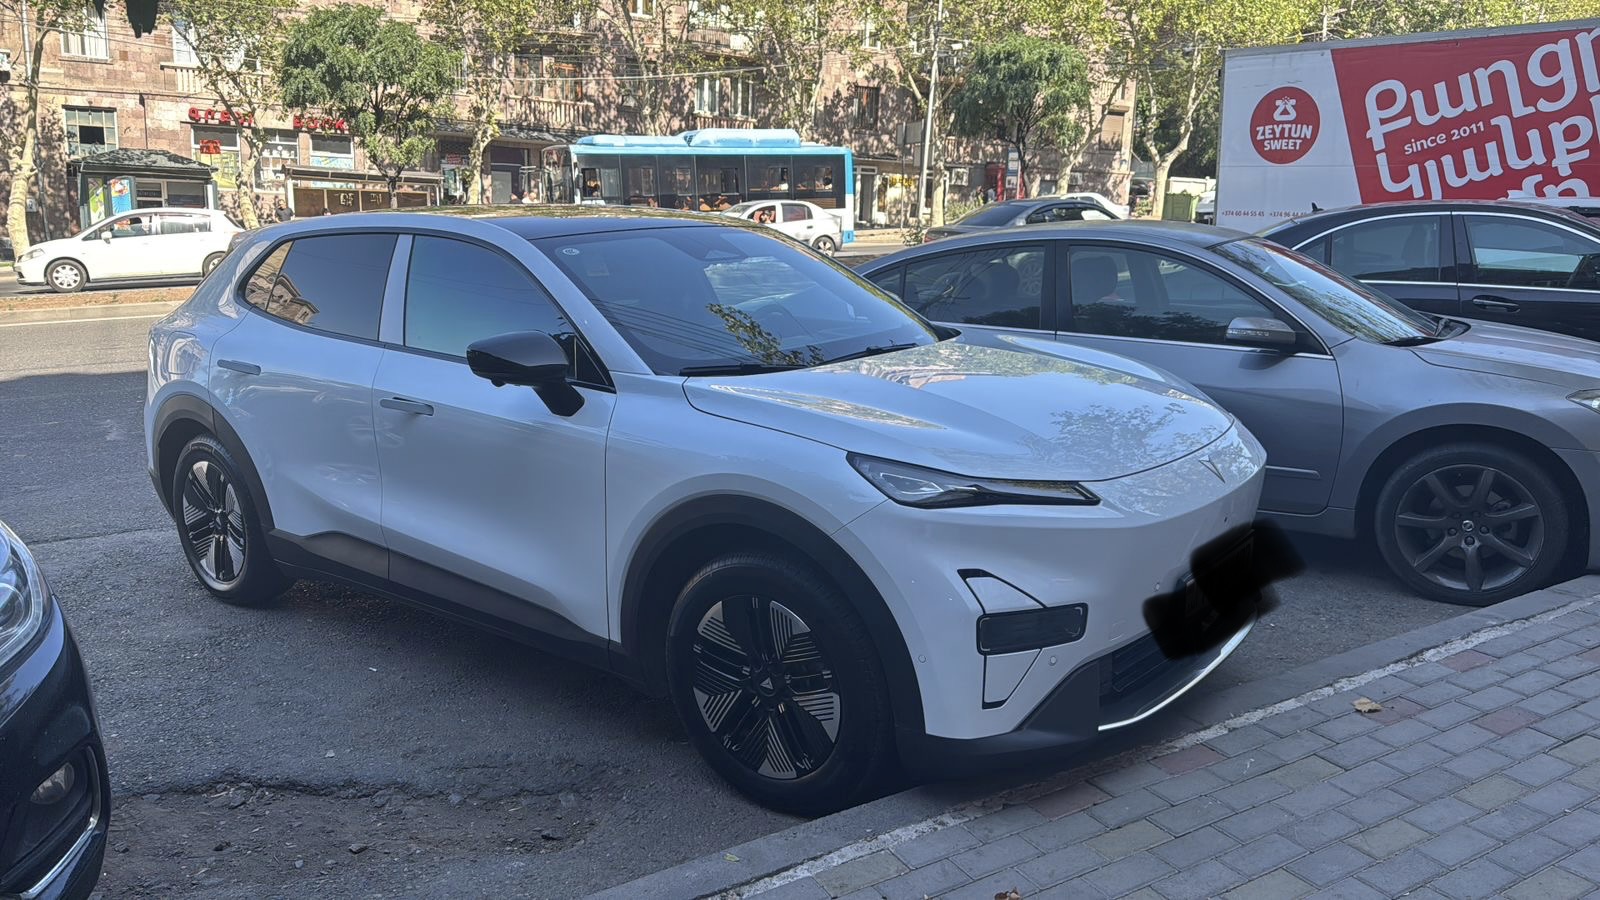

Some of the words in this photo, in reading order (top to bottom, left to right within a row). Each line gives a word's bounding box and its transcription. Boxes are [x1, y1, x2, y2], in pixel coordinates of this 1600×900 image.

[1256, 124, 1313, 140] ZEYTUN
[1404, 133, 1447, 155] since
[1450, 121, 1485, 140] 2011
[1264, 139, 1302, 151] SWEET
